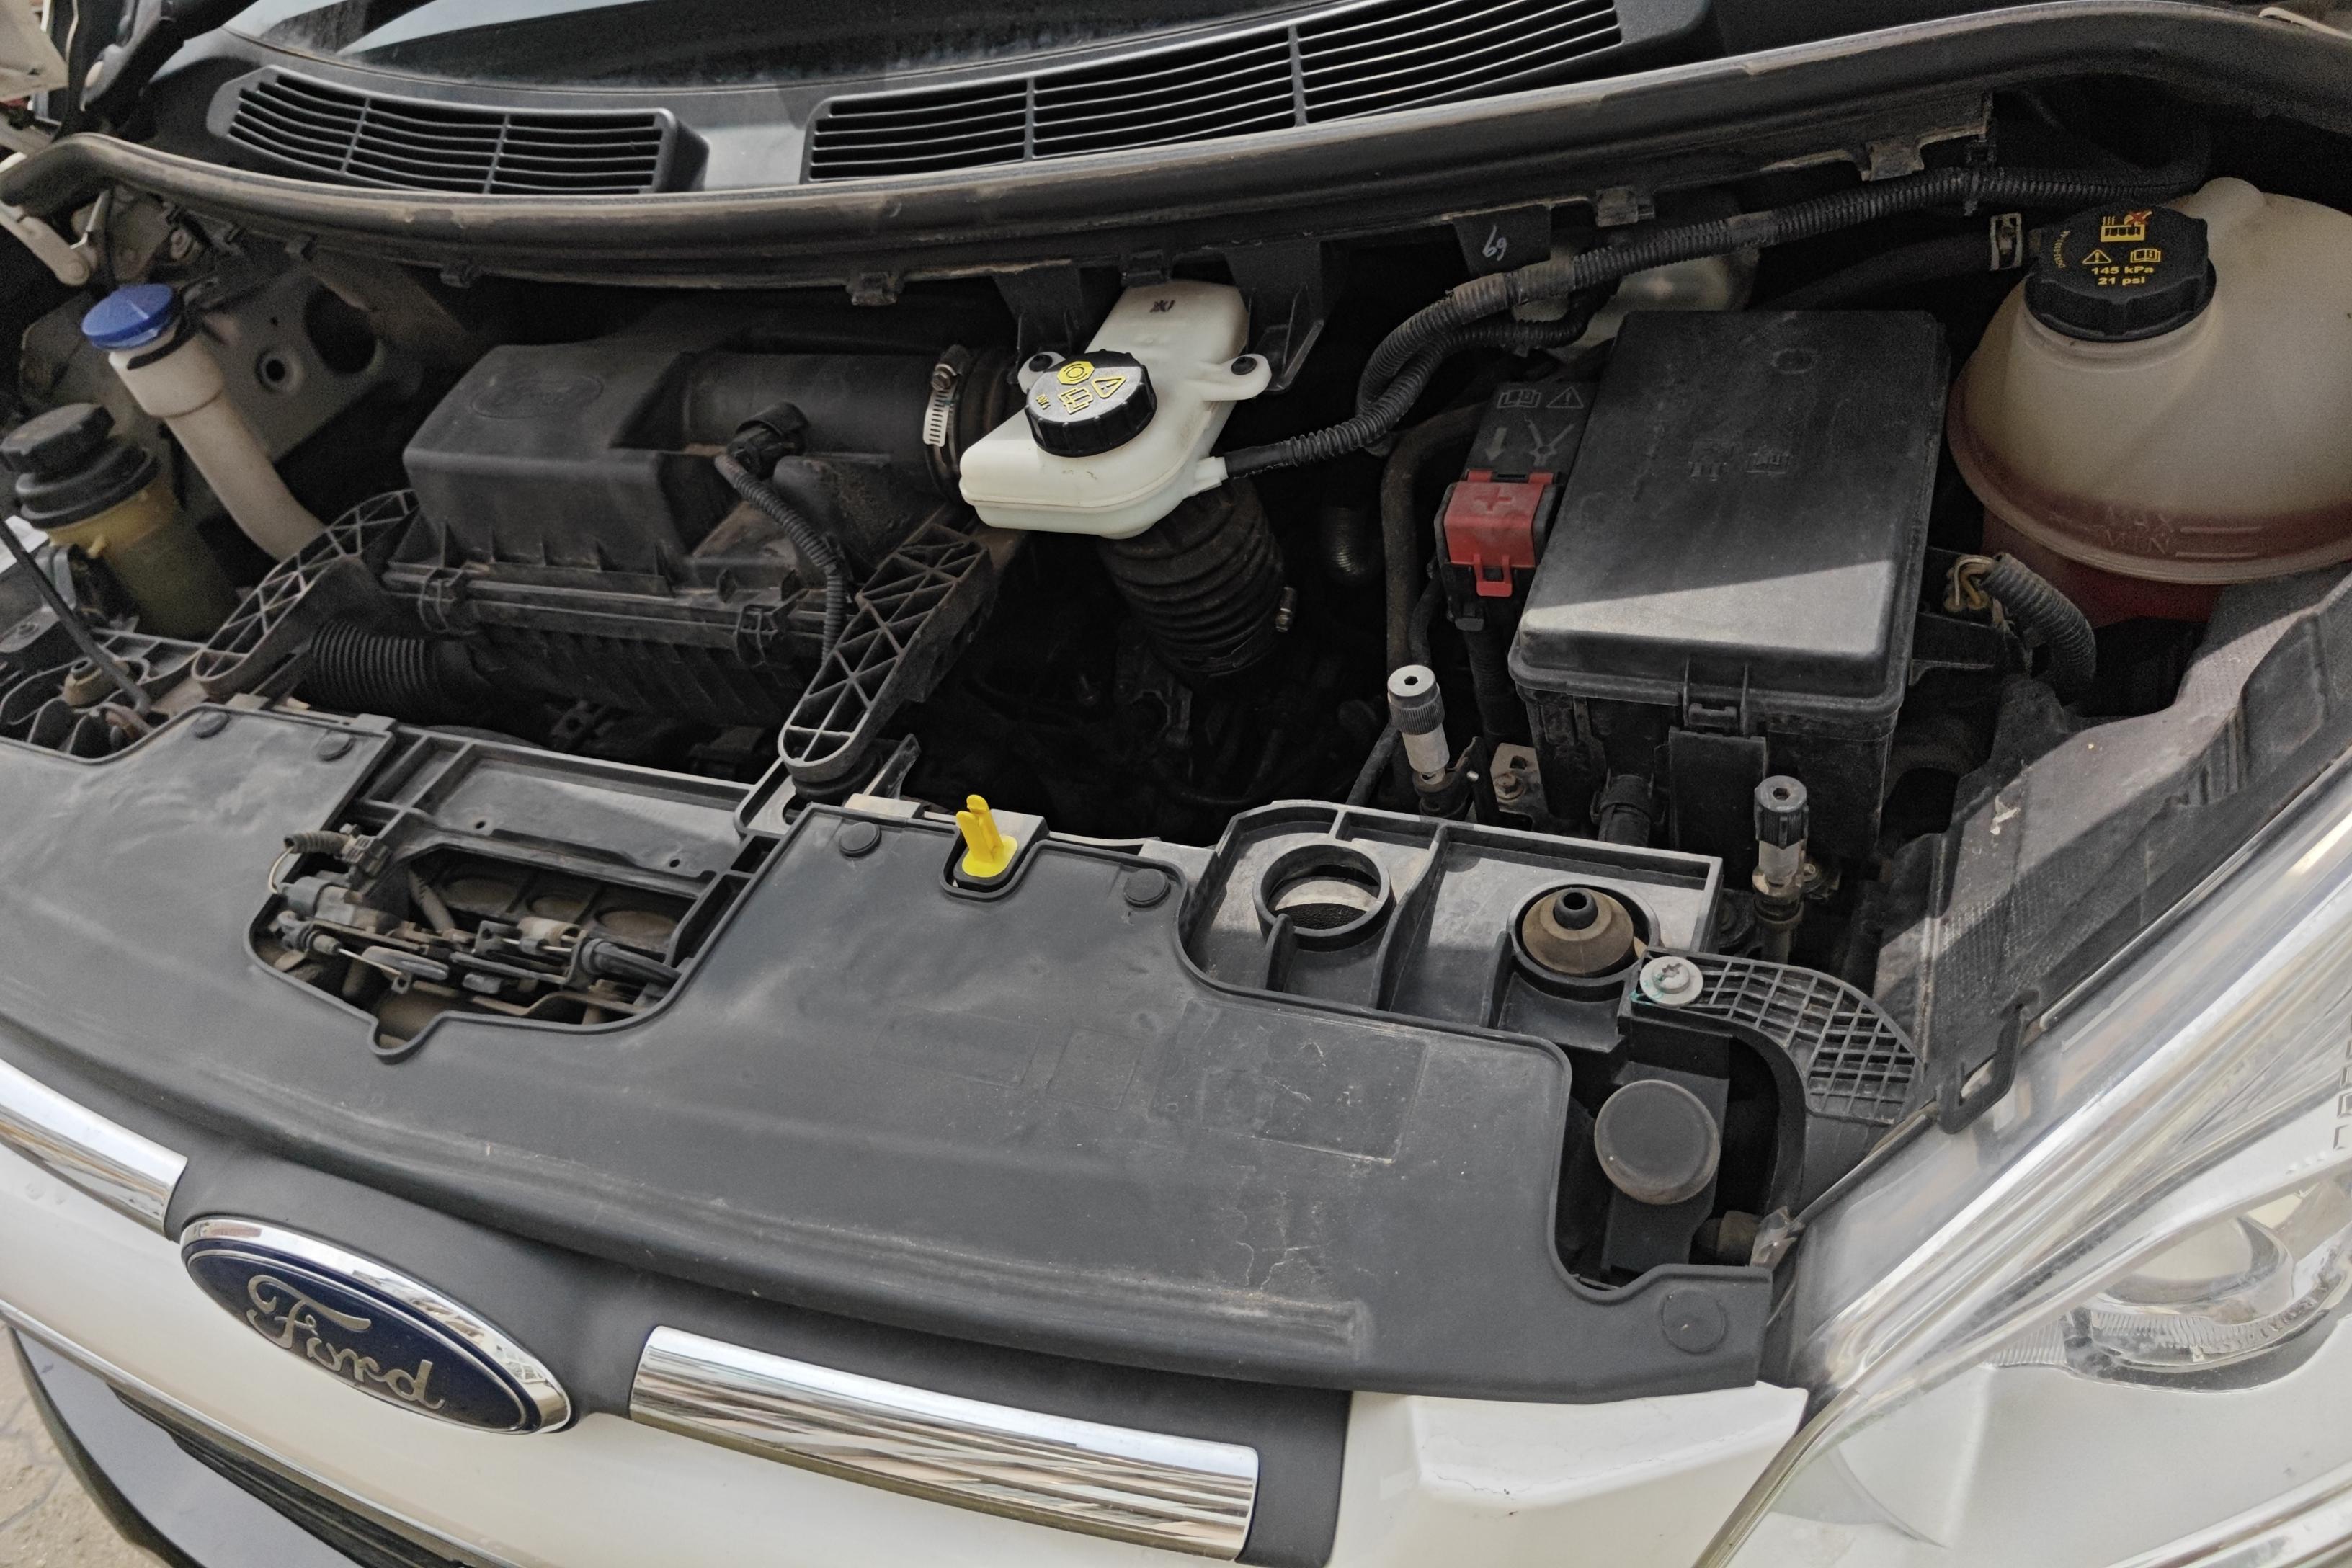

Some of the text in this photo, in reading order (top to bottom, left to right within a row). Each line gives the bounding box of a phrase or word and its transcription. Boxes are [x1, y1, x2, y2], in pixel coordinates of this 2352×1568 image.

[2098, 276, 2145, 286] 21 psi
[246, 1274, 445, 1410] Ford
